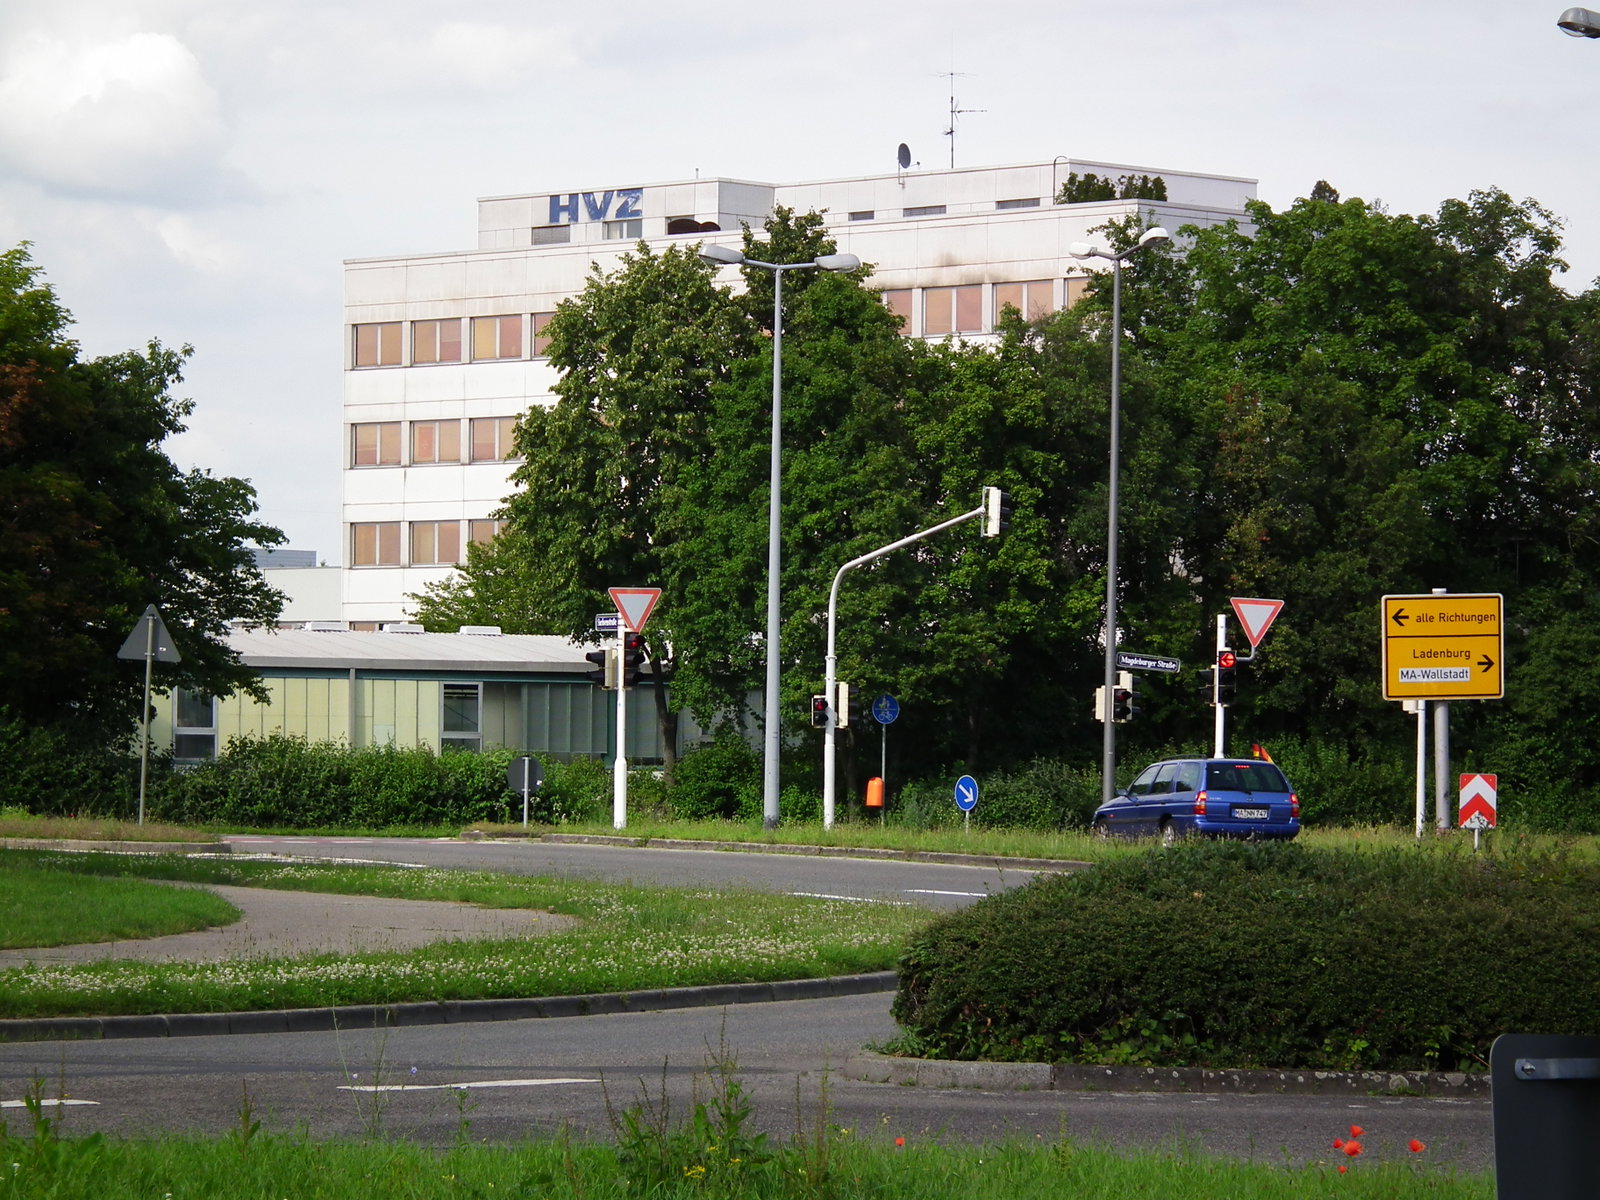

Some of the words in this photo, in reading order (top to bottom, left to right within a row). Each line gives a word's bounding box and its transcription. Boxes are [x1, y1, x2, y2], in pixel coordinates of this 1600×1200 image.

[549, 187, 643, 223] HVZ
[1415, 613, 1435, 623] alle
[1438, 612, 1496, 624] Richtungen
[1412, 649, 1471, 660] Ladenburg
[1121, 656, 1157, 668] Magdeburger
[1400, 669, 1469, 680] MA-Wallstadt
